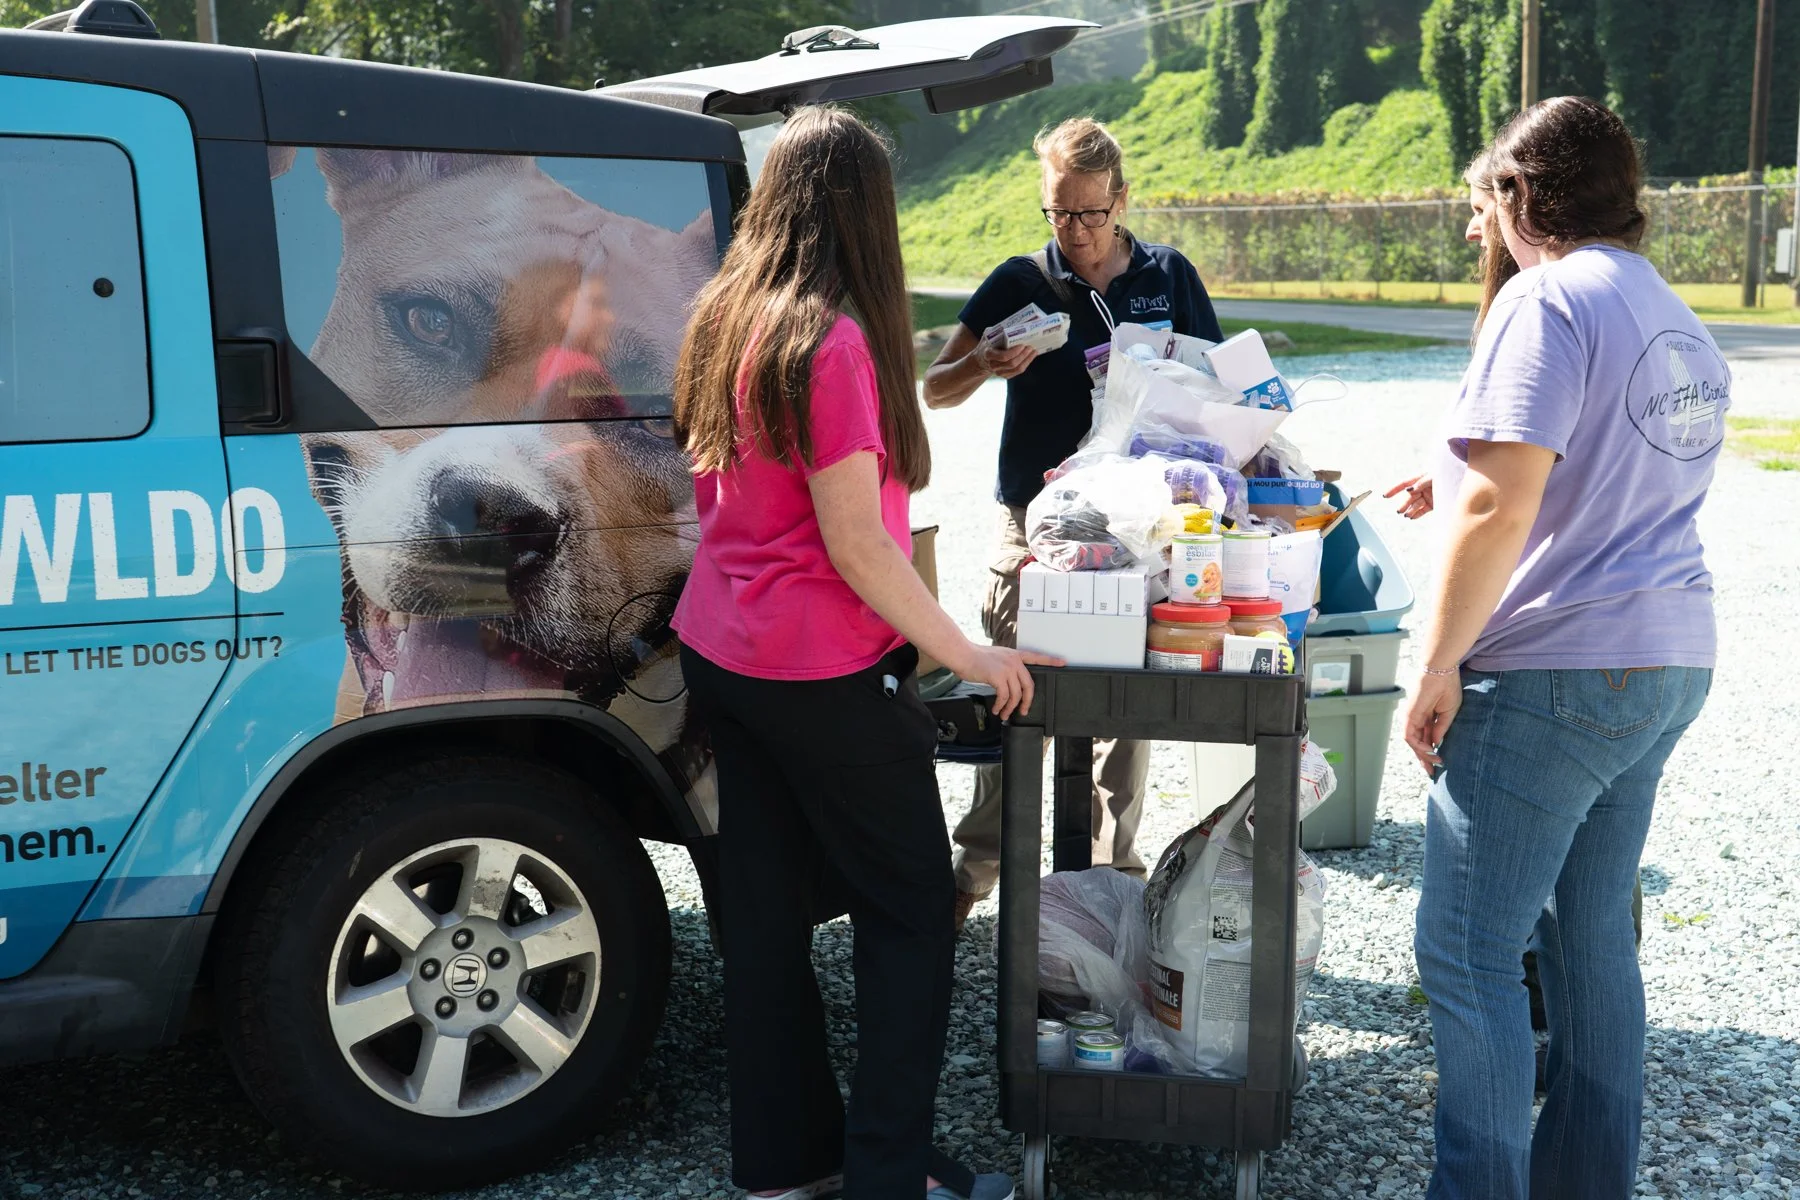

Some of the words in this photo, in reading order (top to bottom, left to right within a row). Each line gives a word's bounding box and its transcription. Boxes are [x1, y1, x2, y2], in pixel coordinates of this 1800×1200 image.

[1641, 392, 1669, 420] NC
[6, 650, 59, 675] LET
[67, 646, 123, 671] THE
[133, 640, 206, 667] DOGS
[215, 635, 283, 661] OUT?
